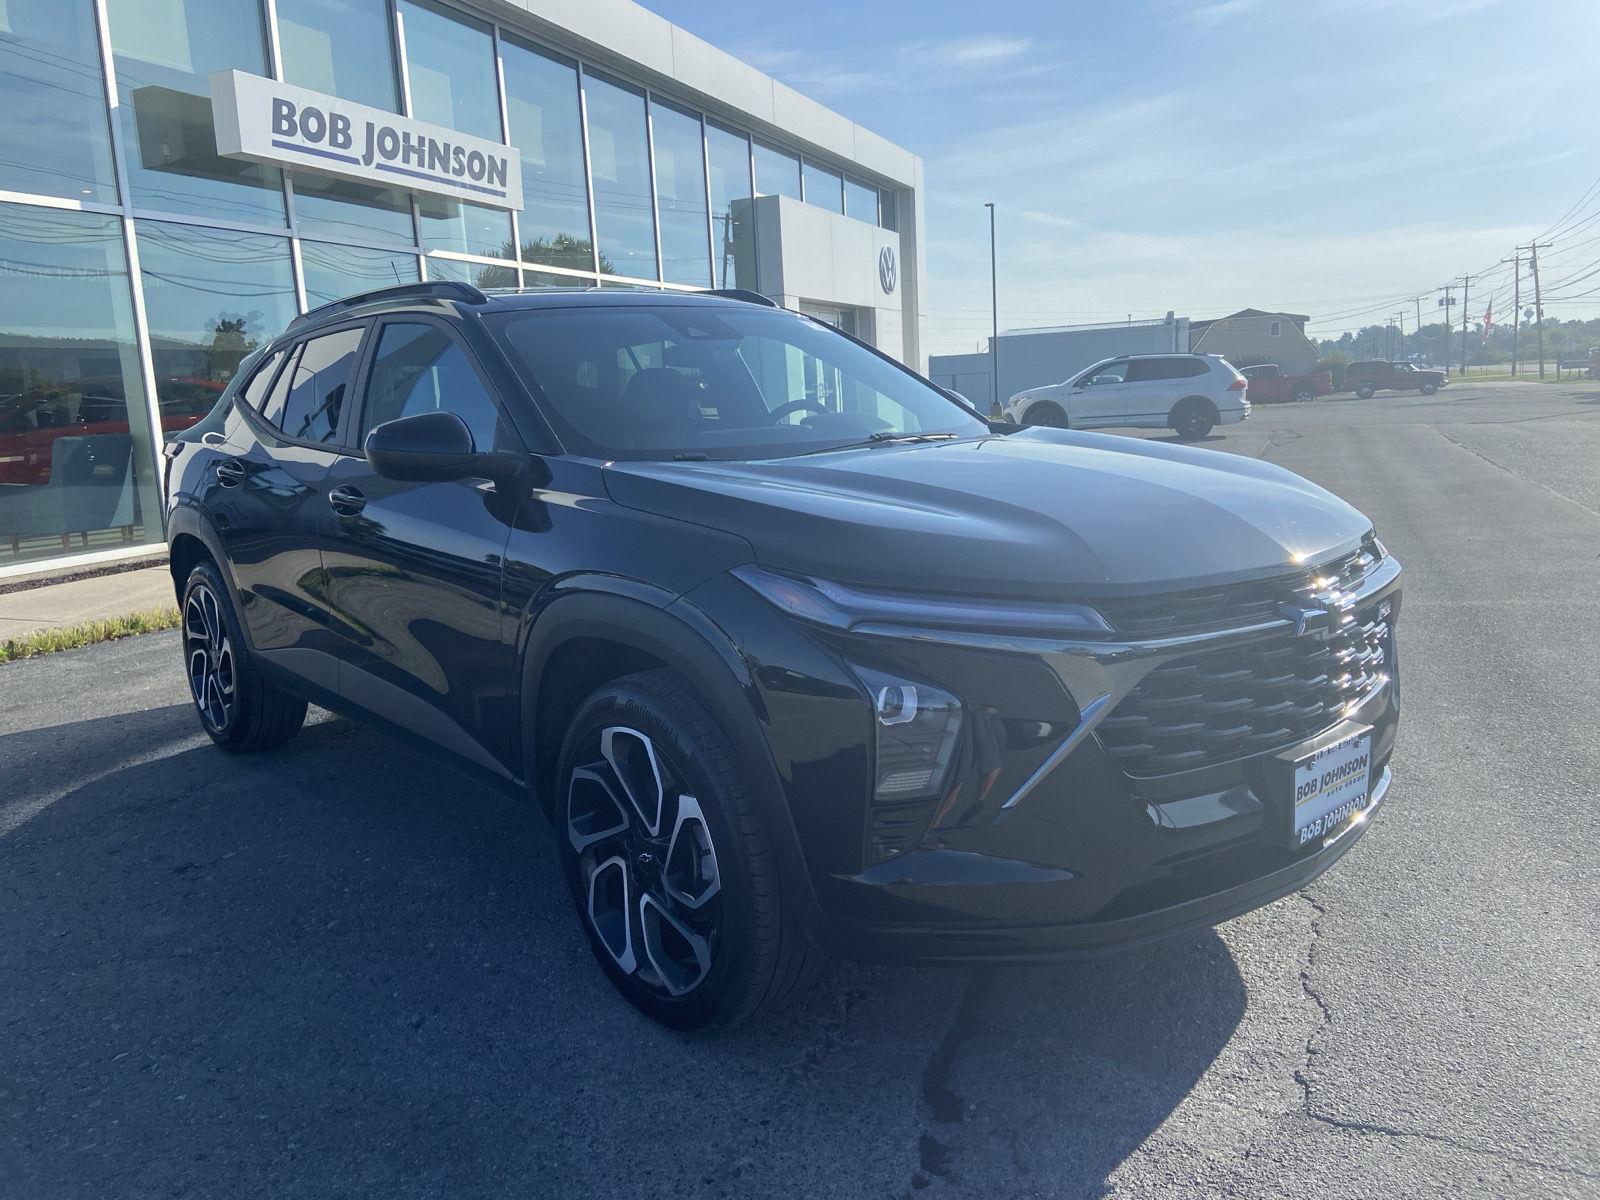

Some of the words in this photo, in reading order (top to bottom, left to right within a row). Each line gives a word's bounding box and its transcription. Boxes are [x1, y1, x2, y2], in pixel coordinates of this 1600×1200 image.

[271, 97, 353, 150] BOB
[361, 121, 508, 188] JOHNSON
[1296, 777, 1318, 802] BOB
[1319, 754, 1368, 793] JOHNSON
[1300, 819, 1321, 844] BOB
[1322, 793, 1368, 836] JOHNSON
